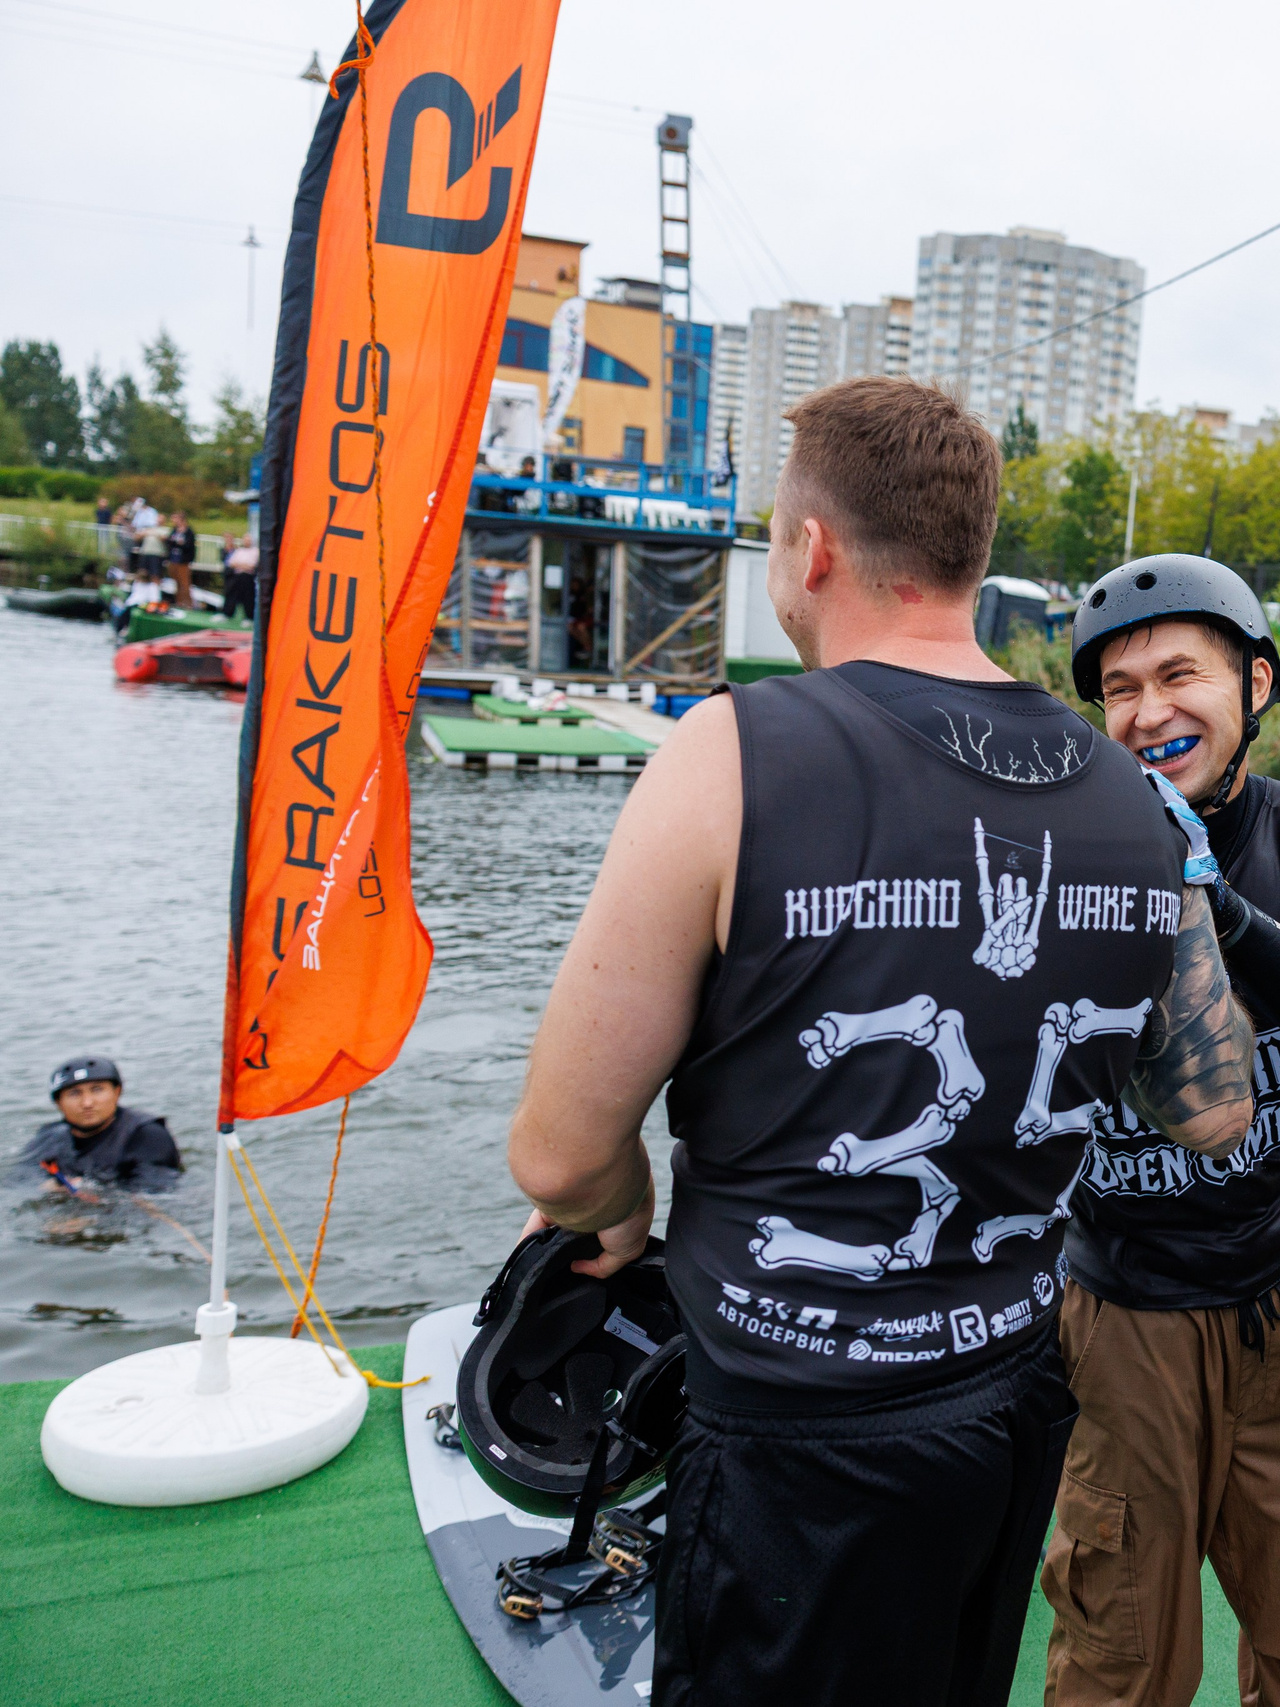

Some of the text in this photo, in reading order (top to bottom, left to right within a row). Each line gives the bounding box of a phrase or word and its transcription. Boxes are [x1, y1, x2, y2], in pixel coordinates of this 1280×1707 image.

[283, 339, 390, 872] RAKETOS
[784, 877, 962, 940] KUPCHINO
[1057, 883, 1139, 932] WAKE
[1086, 1144, 1191, 1194] OPEN
[716, 1300, 837, 1356] АВТОСЕРВИС
[1003, 1298, 1032, 1322] DIRTY
[1007, 1313, 1033, 1335] HABITS
